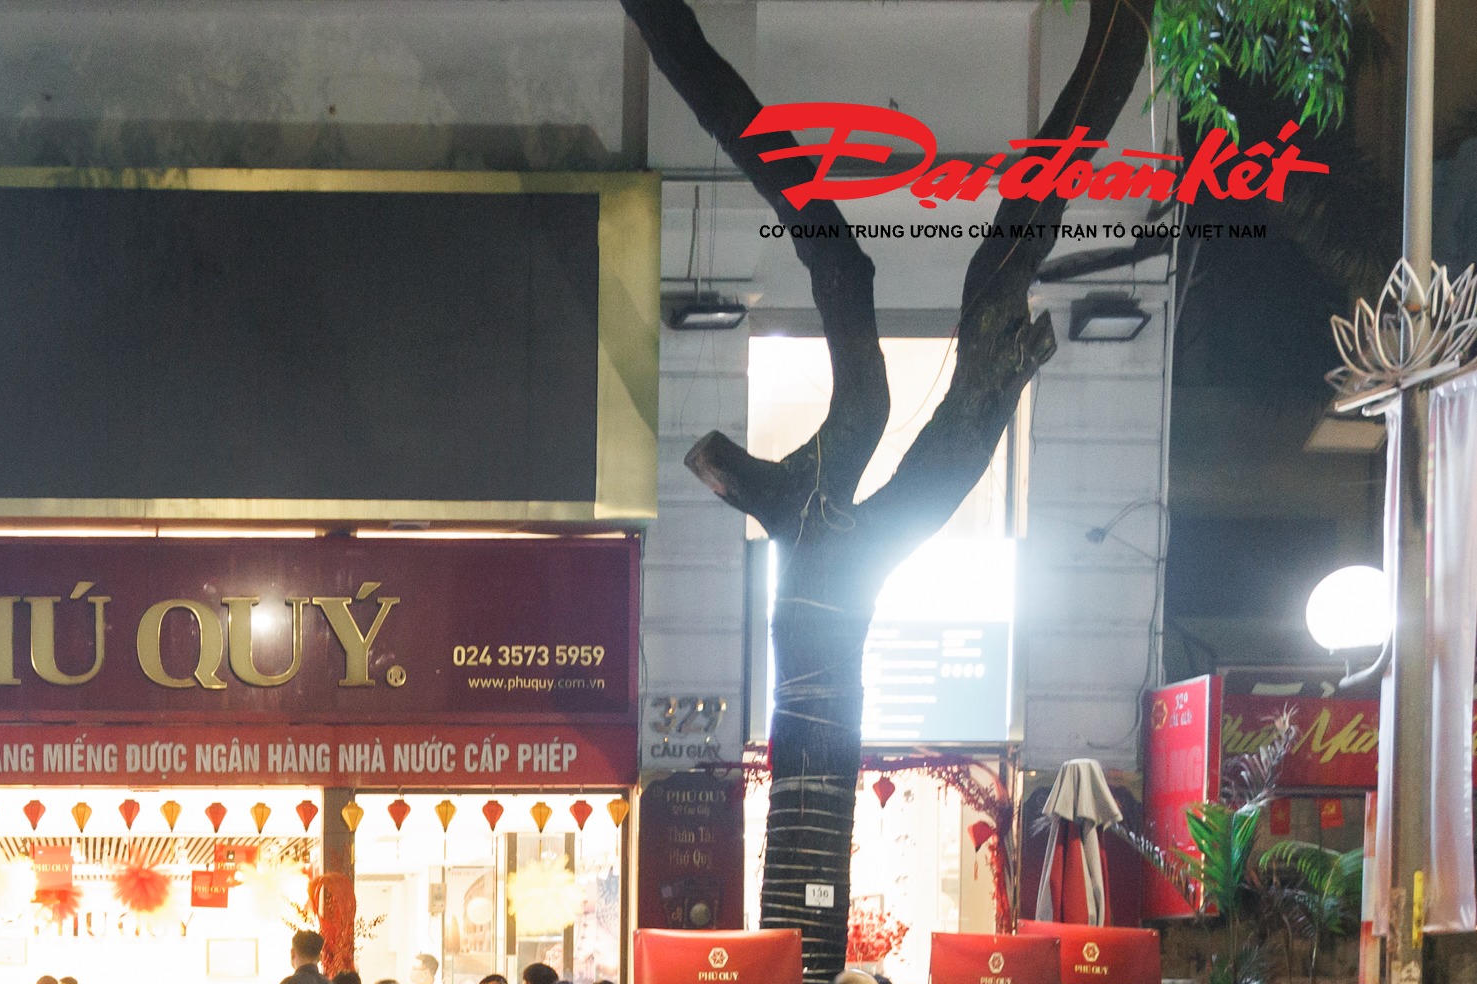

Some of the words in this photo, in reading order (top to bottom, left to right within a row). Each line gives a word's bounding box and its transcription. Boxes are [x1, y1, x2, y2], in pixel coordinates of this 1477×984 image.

[136, 581, 401, 689] QUÝ
[453, 645, 492, 667] 024
[498, 645, 549, 667] 3573
[555, 645, 605, 667] 5959
[468, 676, 605, 692] www.phuquy.com.vn
[43, 733, 118, 773] MIẾNG
[126, 740, 188, 780] ĐƯỢC
[196, 737, 260, 773] NGÂN
[268, 737, 331, 773] HÀNG
[338, 737, 386, 773] NHÀ
[394, 735, 457, 773] NƯỚC
[464, 733, 511, 773] CẤP
[517, 736, 578, 773] PHÉP
